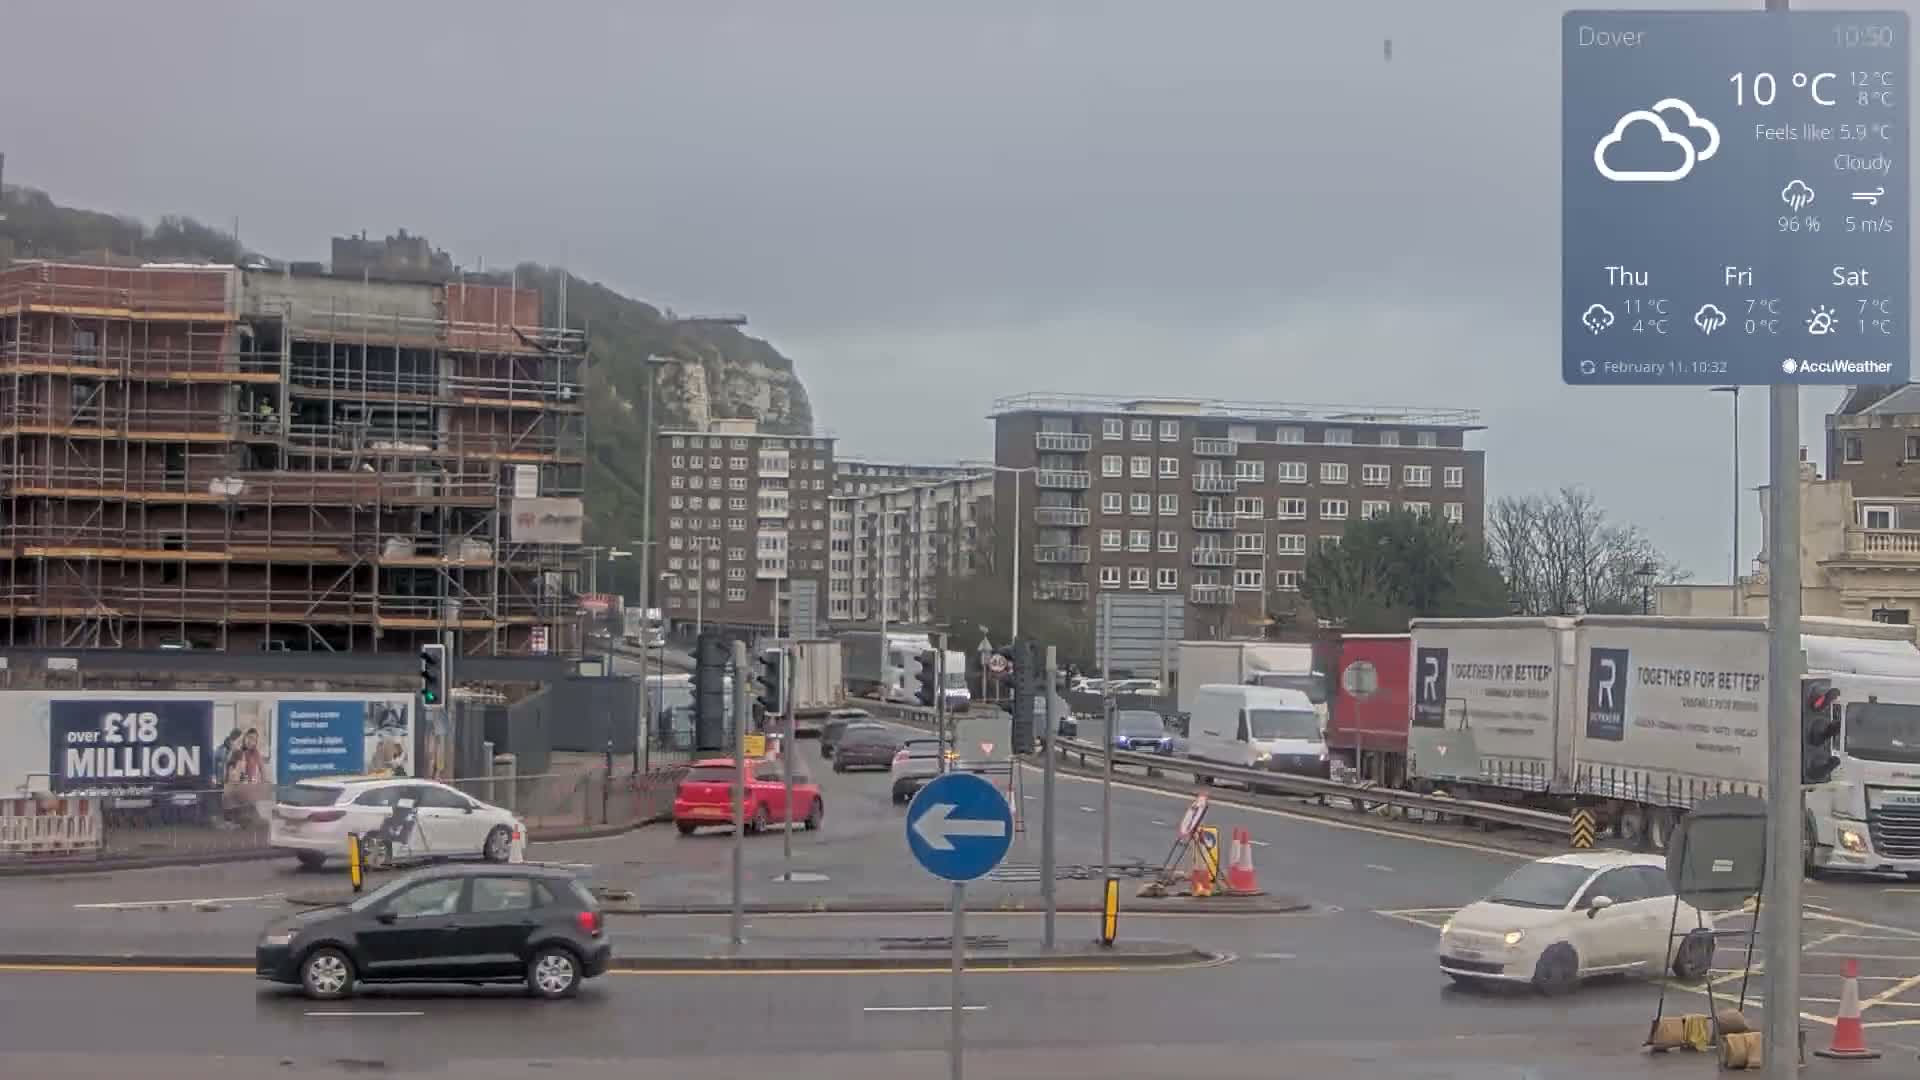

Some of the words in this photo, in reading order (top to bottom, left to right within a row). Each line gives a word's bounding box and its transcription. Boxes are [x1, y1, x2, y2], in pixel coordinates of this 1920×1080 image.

[1495, 664, 1513, 680] FOR
[1638, 667, 1691, 687] TOGETHER
[1694, 671, 1715, 688] FOR
[67, 730, 100, 742] over
[105, 712, 159, 743] £18
[67, 746, 201, 778] MILLION
